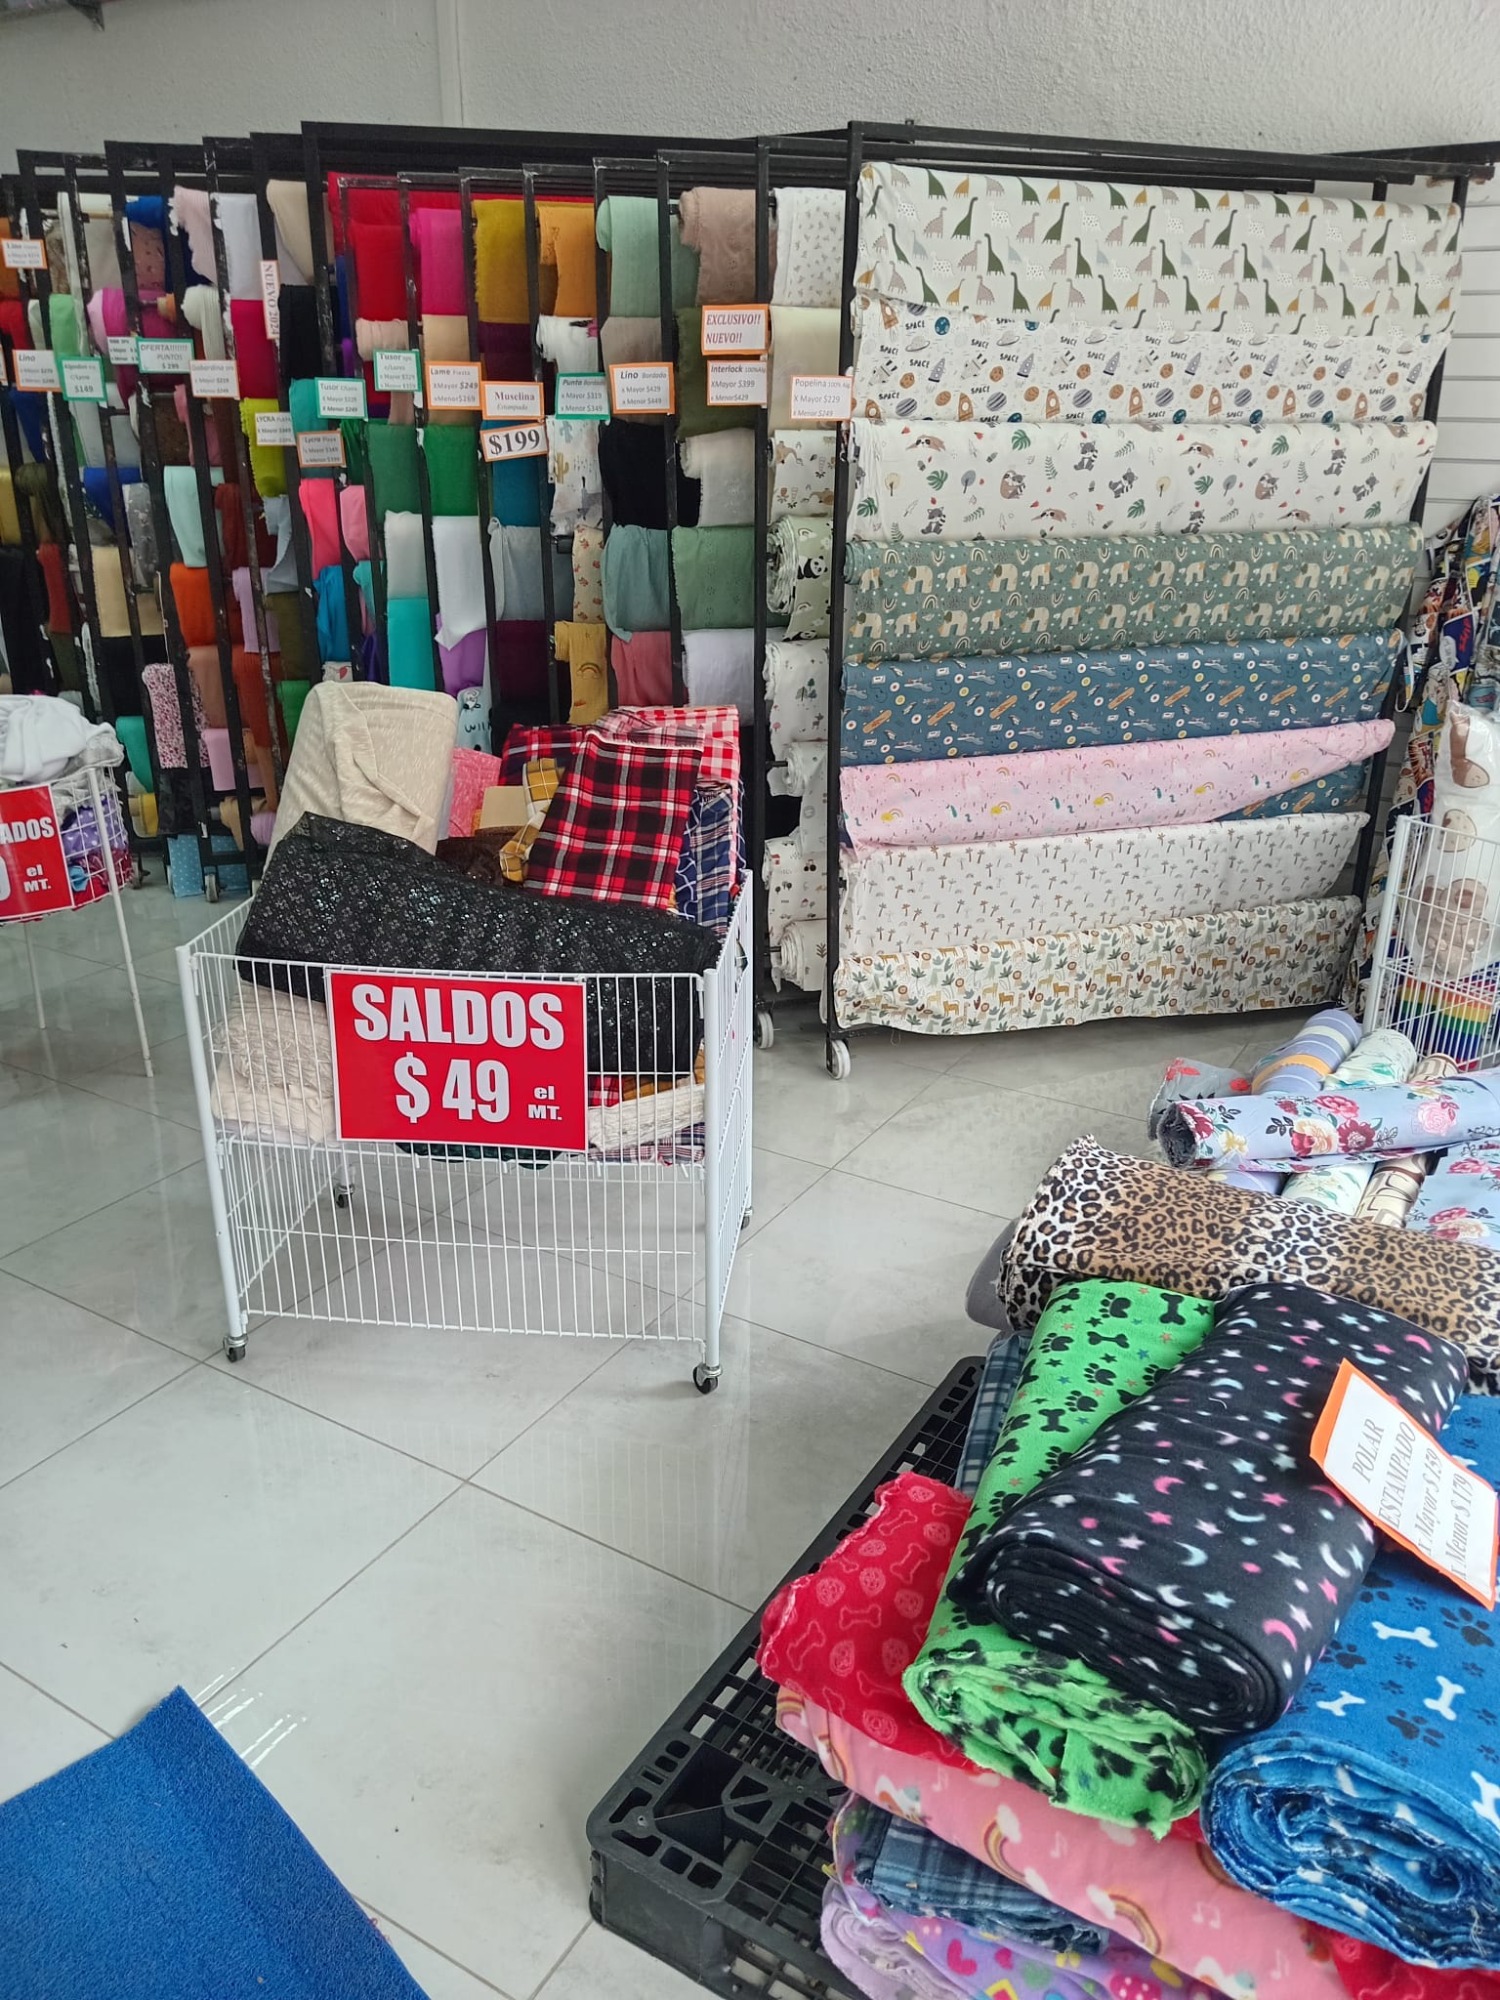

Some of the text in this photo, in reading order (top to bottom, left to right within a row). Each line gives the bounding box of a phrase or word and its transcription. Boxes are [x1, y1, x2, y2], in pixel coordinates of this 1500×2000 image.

[263, 264, 280, 335] NUEVO 2024
[706, 313, 761, 325] EXCLUSIVO!!
[706, 332, 742, 344] NUEVO!!
[380, 353, 401, 361] Tusor
[430, 368, 451, 376] Lame
[620, 371, 639, 380] Lino
[711, 365, 743, 374] Interlock
[460, 381, 479, 391] $249
[626, 386, 645, 395] Mayor
[795, 379, 826, 389] Popelina
[801, 394, 823, 404] Mayor
[488, 429, 540, 456] $199
[26, 864, 43, 877] el
[24, 878, 52, 893] MT.
[352, 984, 565, 1050] SALDOS
[394, 1052, 510, 1124] $ 49
[534, 1086, 555, 1100] el
[528, 1104, 563, 1120] MT.
[1352, 1419, 1384, 1484] POLAR
[1424, 1448, 1443, 1479] 159
[1378, 1421, 1416, 1529] ESTAMPADO
[1453, 1473, 1473, 1503] 179
[1415, 1490, 1441, 1539] Mayor
[1446, 1513, 1468, 1566] Menor
